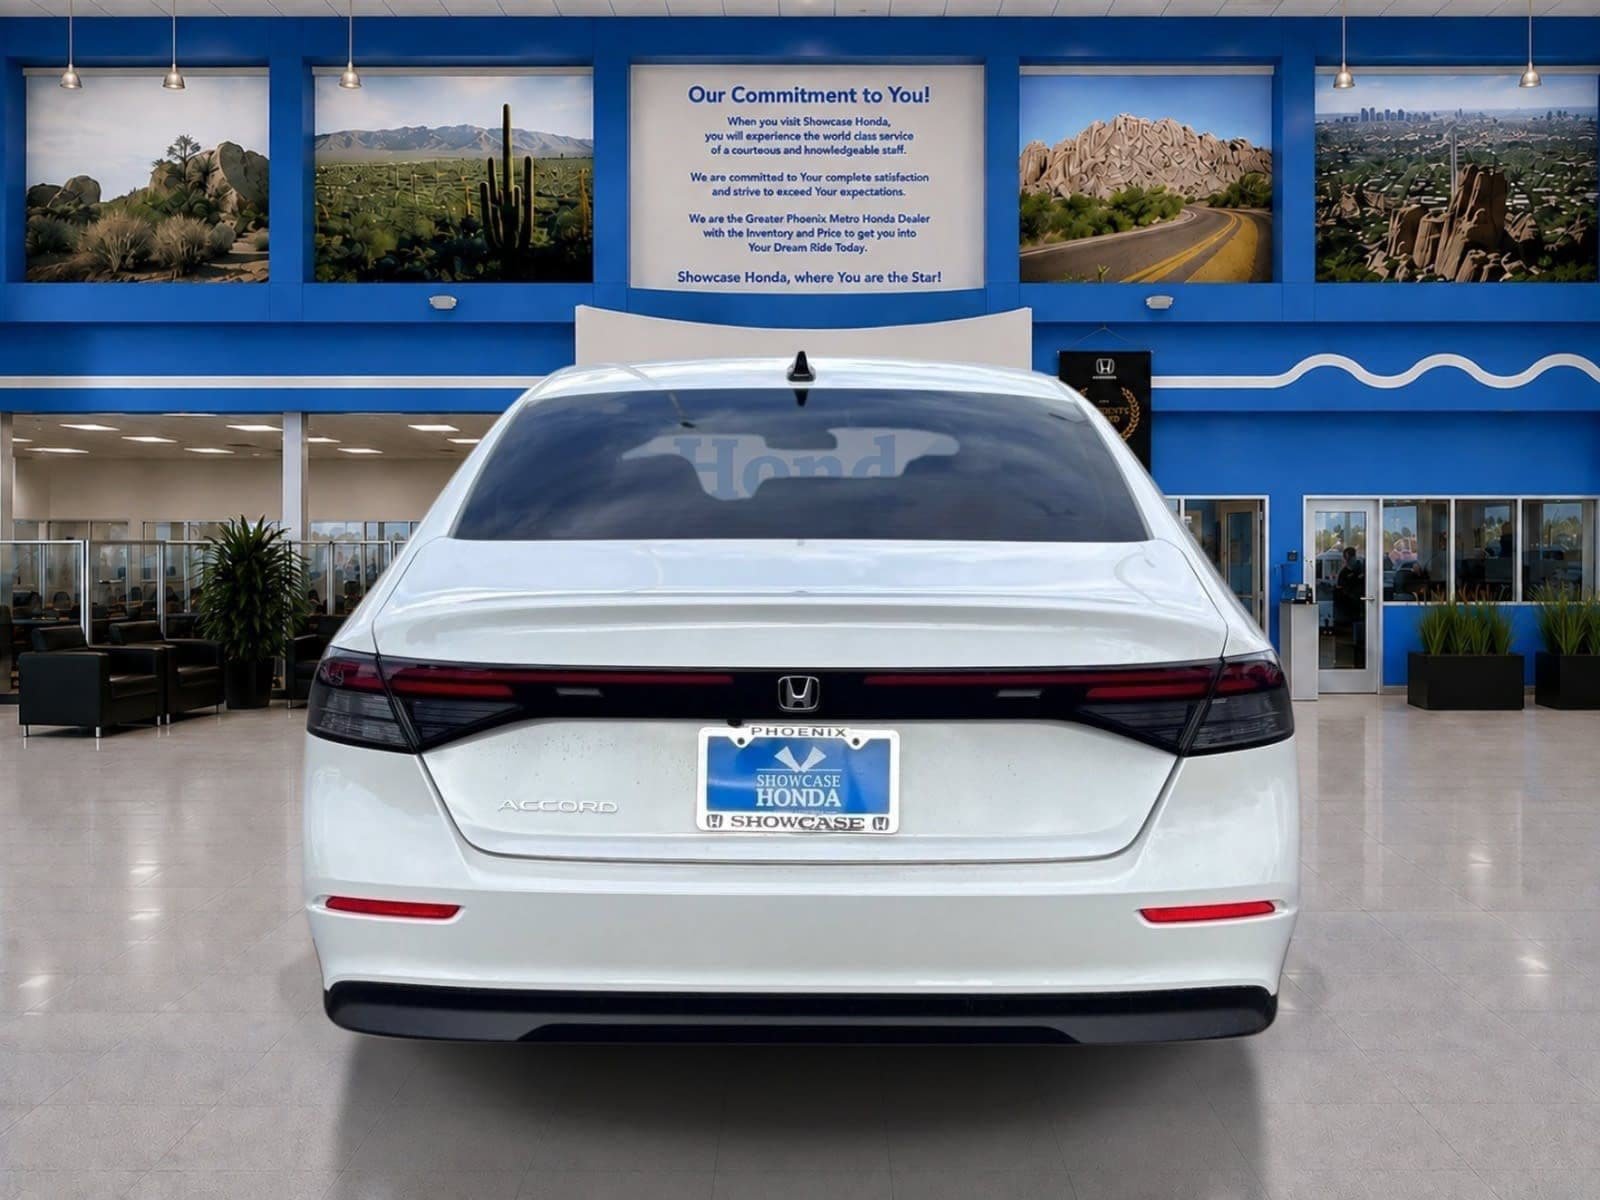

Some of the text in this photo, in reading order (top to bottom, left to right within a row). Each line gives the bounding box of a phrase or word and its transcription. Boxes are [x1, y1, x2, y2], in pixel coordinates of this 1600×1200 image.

[688, 85, 930, 104] Our Commitment to You!
[727, 116, 892, 129] When you visit Showcase Honda,
[704, 130, 915, 144] you will experience the world class service
[710, 144, 722, 155] of
[722, 147, 730, 155] a
[731, 146, 782, 155] courteous
[783, 144, 803, 155] and
[881, 144, 907, 155] staff.
[689, 171, 930, 185] We are committed to Your complete satisfaction
[711, 185, 906, 200] and strive to exceed Your expectations.
[688, 213, 931, 224] We are the Greater Phoenix Metro Honda Dealer
[702, 227, 917, 241] with the Inventory and Price to get you into
[747, 242, 868, 255] Your Dream Ride Today.
[677, 270, 942, 285] Showcase Honda, where You are the Star!
[751, 726, 847, 738] PHOENIX
[756, 774, 841, 788] SHOWCASE
[755, 787, 843, 808] HONDA
[498, 799, 619, 813] ACCORD
[730, 815, 866, 831] SHOWCASE
